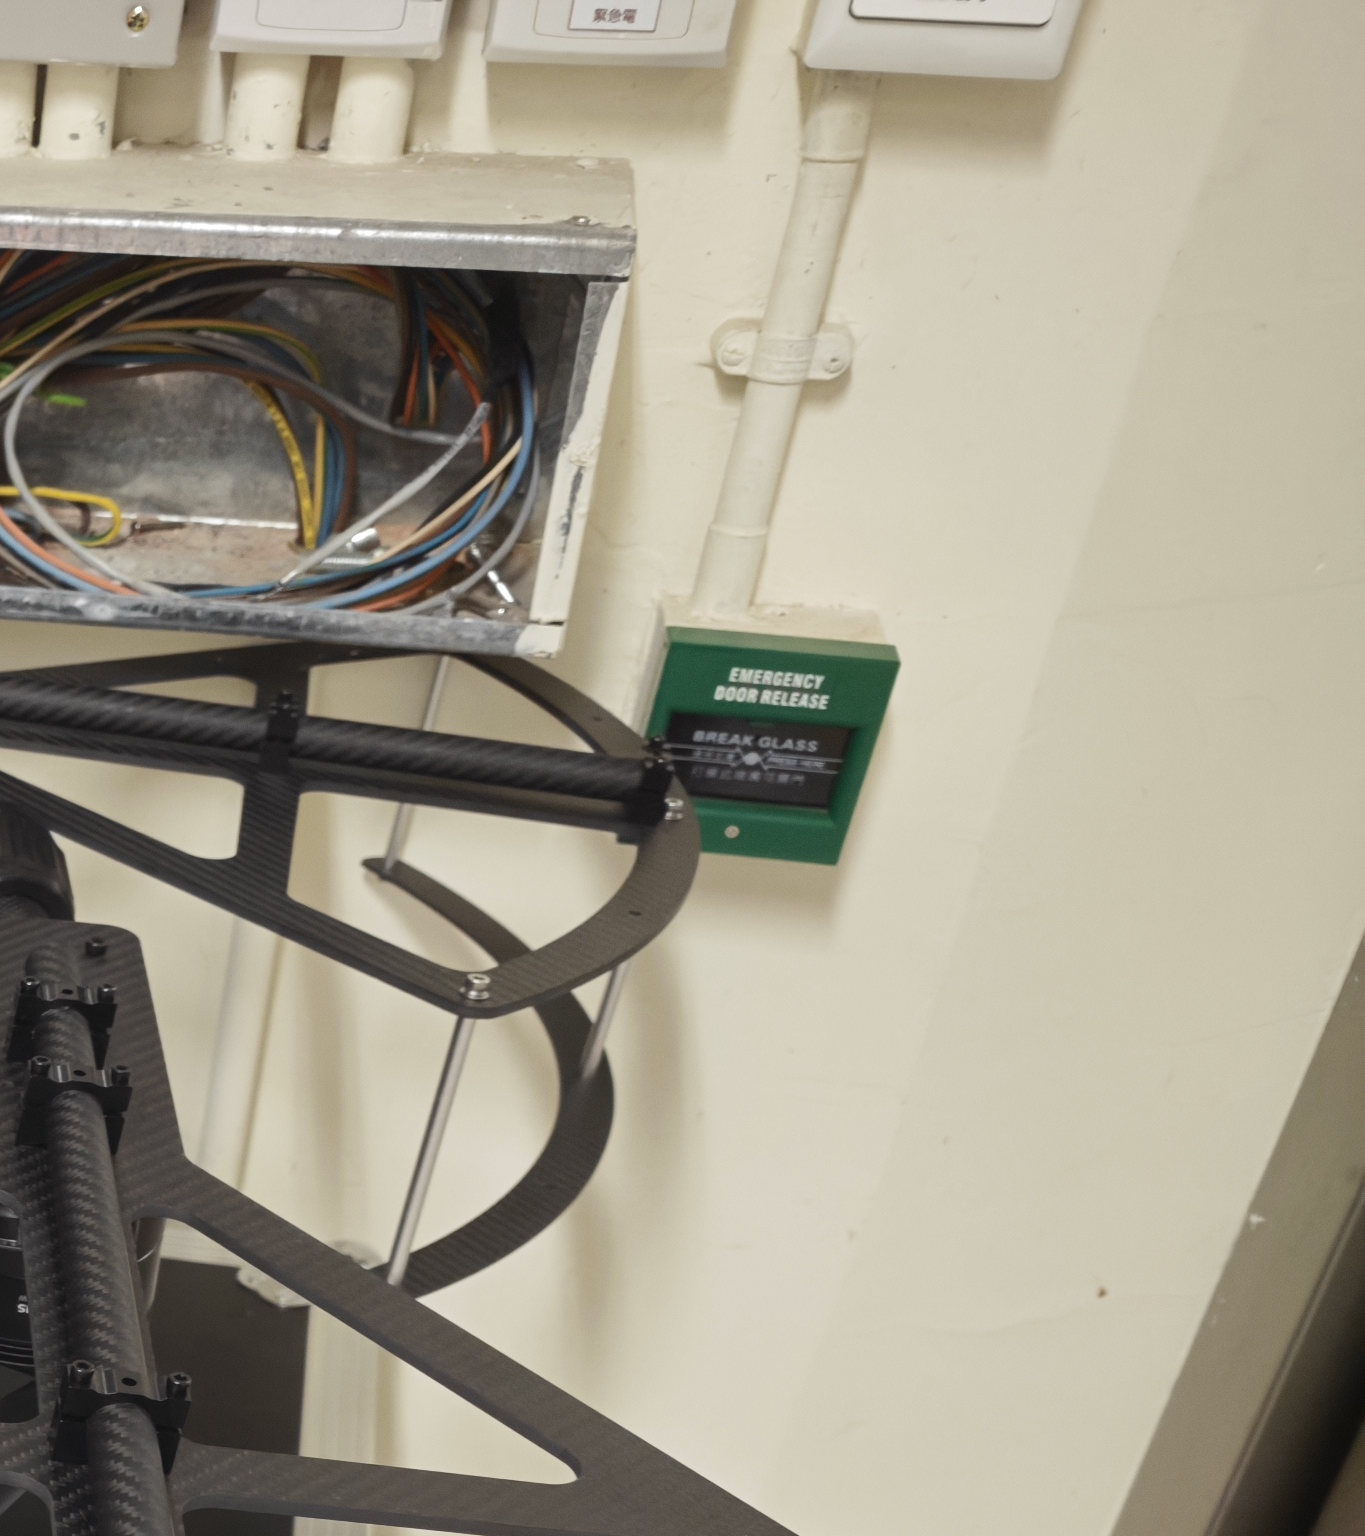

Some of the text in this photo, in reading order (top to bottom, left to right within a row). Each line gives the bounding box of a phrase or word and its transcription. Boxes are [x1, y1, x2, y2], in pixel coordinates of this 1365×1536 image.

[728, 667, 825, 690] EMERGENCY
[713, 685, 830, 710] DOOR RELEASE
[693, 730, 819, 753] BREAK GLASS
